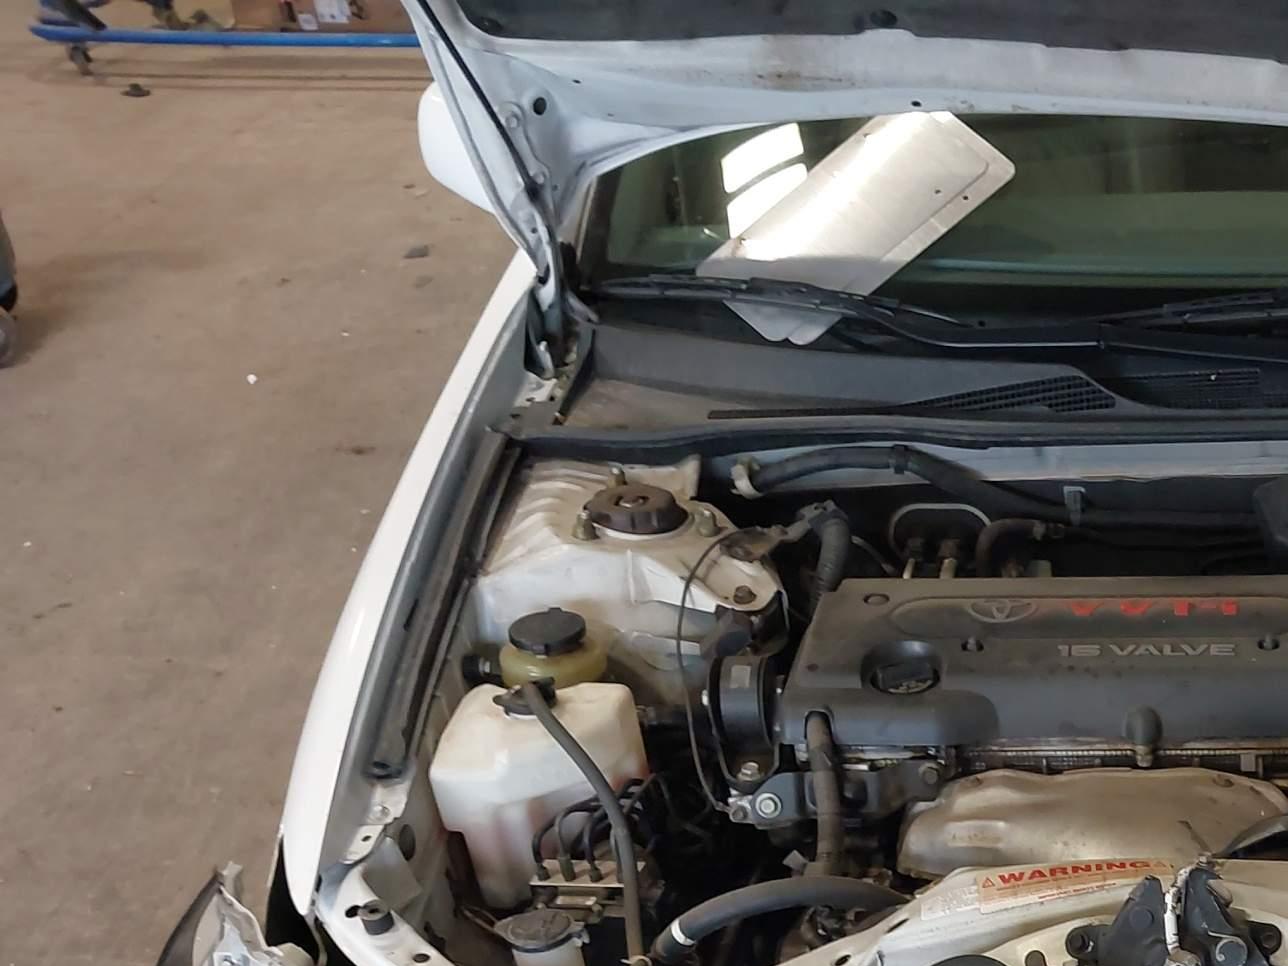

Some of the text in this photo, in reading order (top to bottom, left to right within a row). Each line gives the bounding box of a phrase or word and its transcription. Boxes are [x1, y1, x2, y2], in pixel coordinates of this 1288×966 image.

[1058, 644, 1235, 657] 16 VALVE
[998, 860, 1151, 885] WARNING
